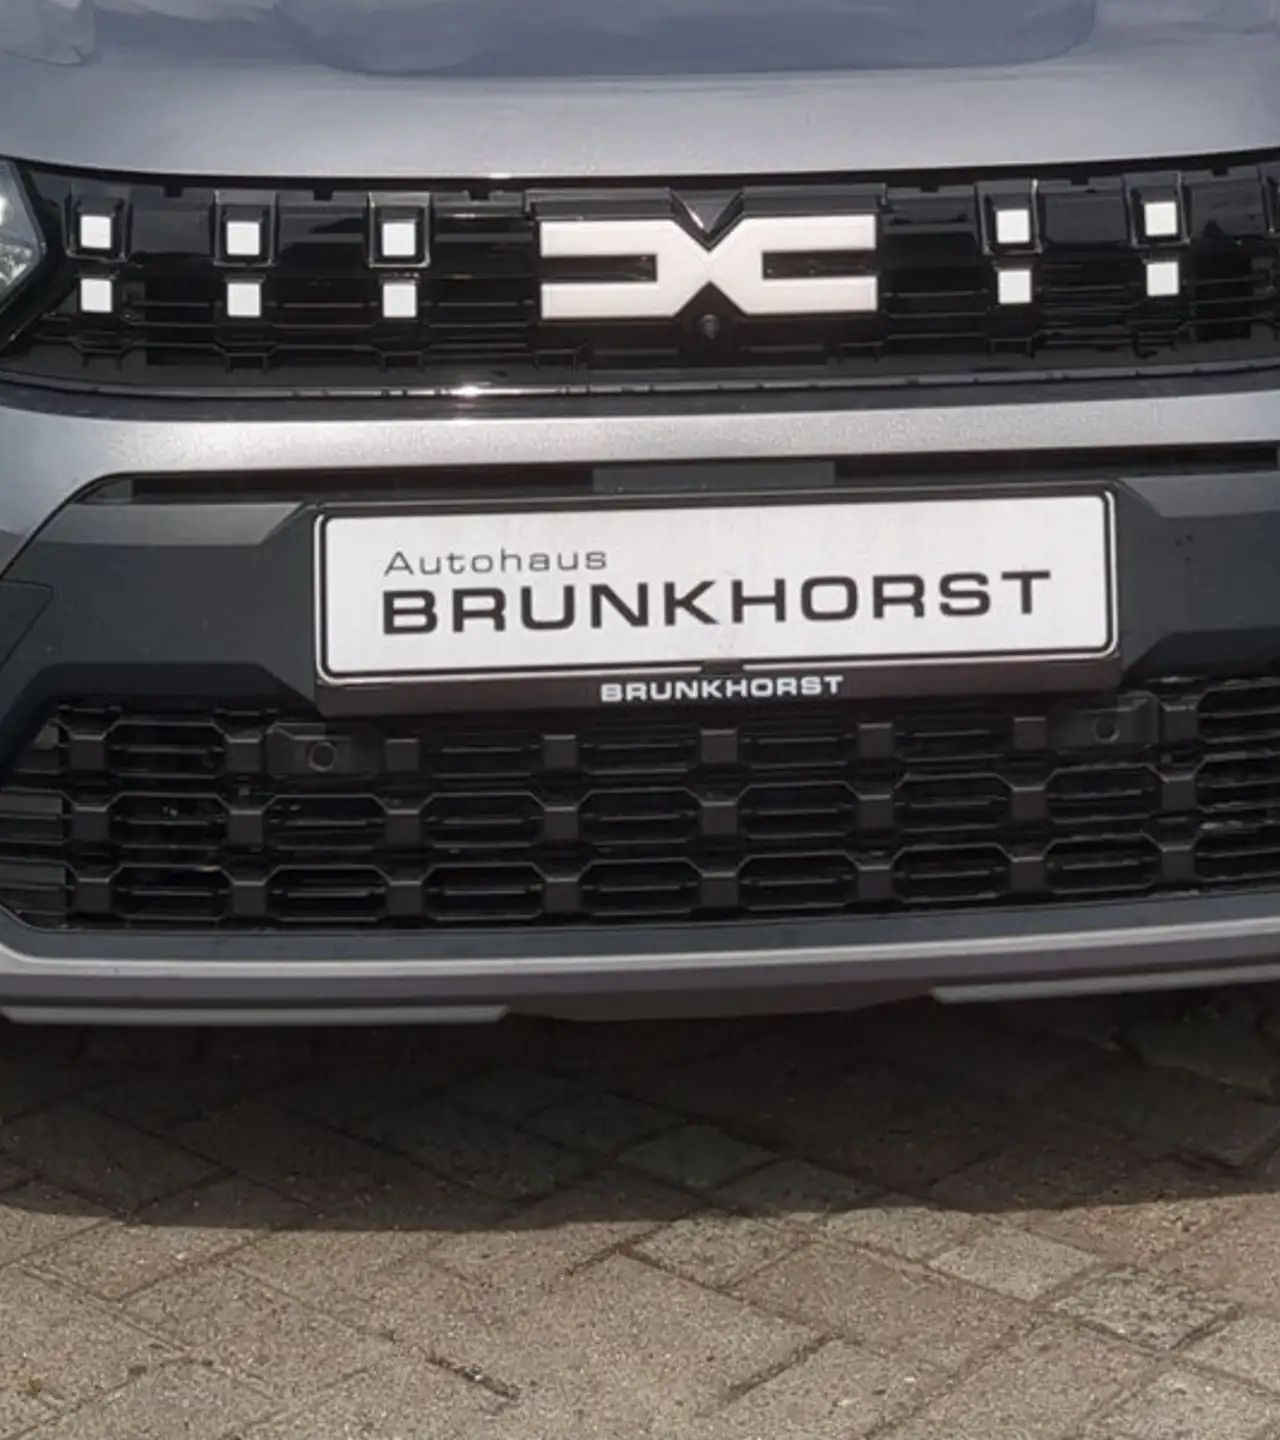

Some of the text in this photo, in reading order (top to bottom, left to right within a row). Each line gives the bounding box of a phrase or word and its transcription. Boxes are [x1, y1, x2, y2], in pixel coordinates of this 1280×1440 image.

[384, 547, 608, 576] Autohaus
[382, 570, 1052, 635] BRUNKHORST
[600, 675, 844, 702] BRUNKHORST
